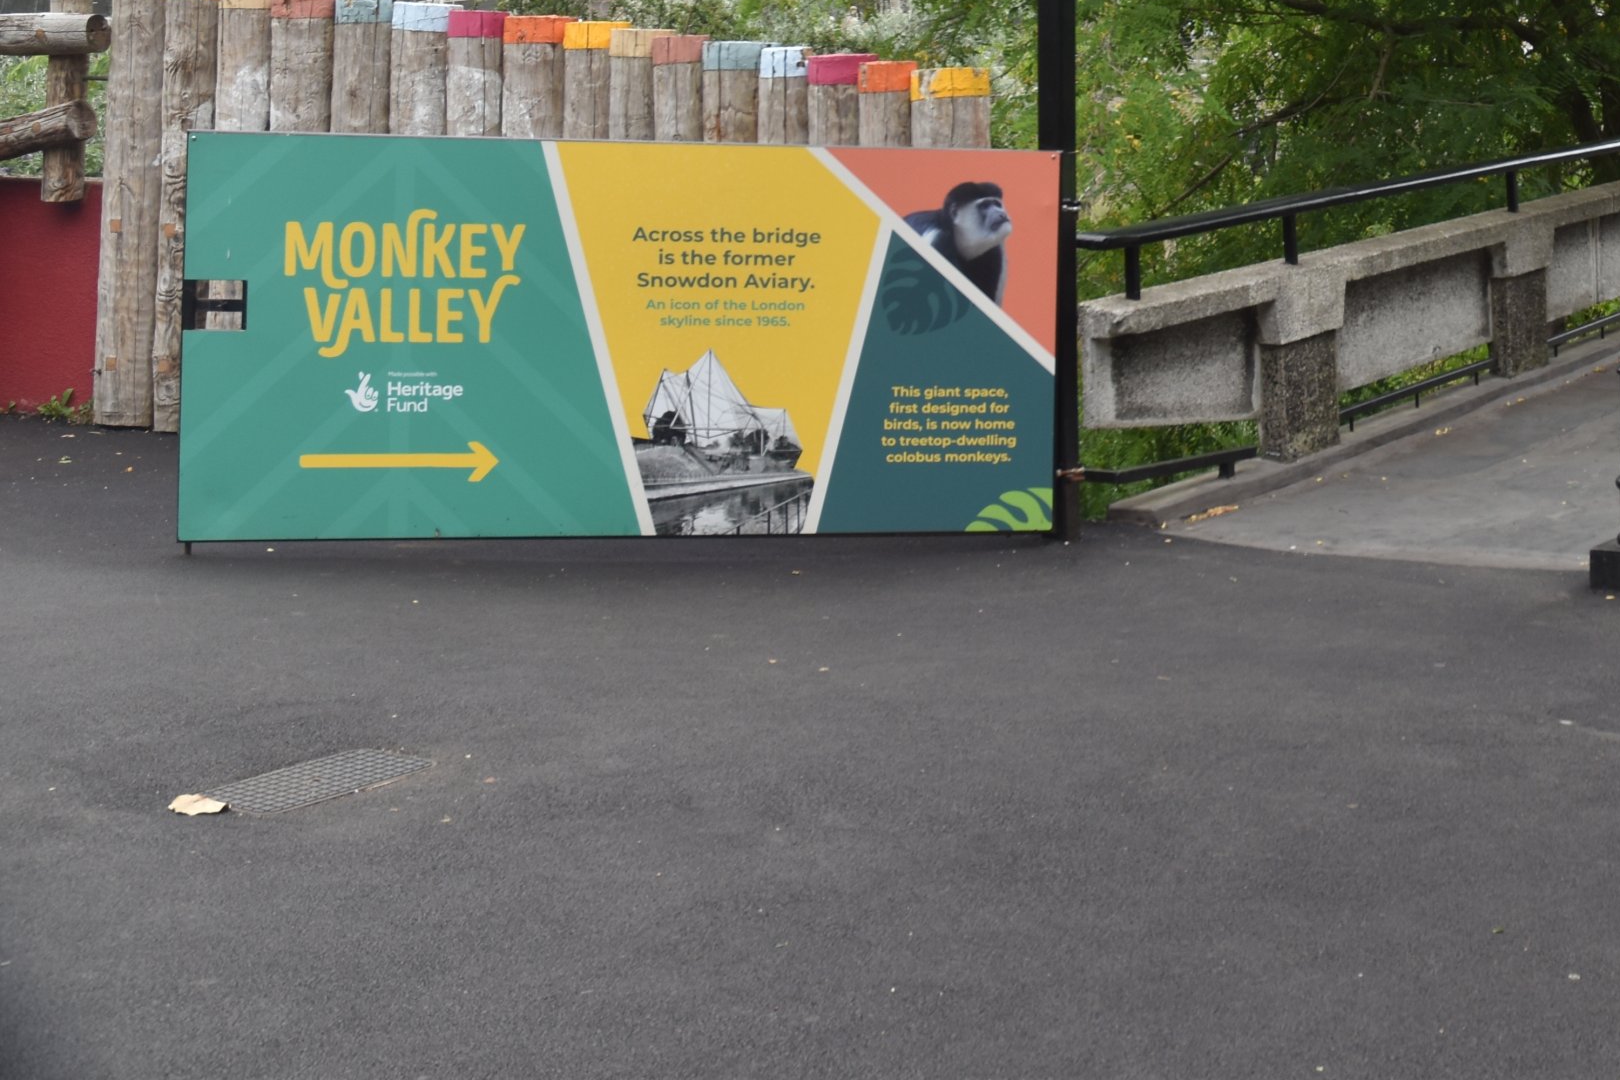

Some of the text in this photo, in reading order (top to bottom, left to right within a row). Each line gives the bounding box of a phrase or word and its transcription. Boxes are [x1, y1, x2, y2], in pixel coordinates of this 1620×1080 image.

[632, 226, 822, 248] Across the bridge
[284, 208, 526, 288] MONKEY
[658, 248, 796, 266] is the former
[636, 272, 816, 292] Snowdon Aviary.
[646, 298, 806, 312] An icon of the London
[304, 274, 521, 357] VALLEY
[660, 314, 790, 328] skyline since 1965.
[387, 381, 464, 400] Heritage
[891, 386, 1008, 400] This giant space,
[387, 397, 428, 412] Fund
[889, 402, 1010, 416] first designed for
[883, 418, 1016, 432] birds, is now home
[881, 434, 1017, 448] to treetop-dwelling
[886, 451, 1012, 464] colobus monkeys.
